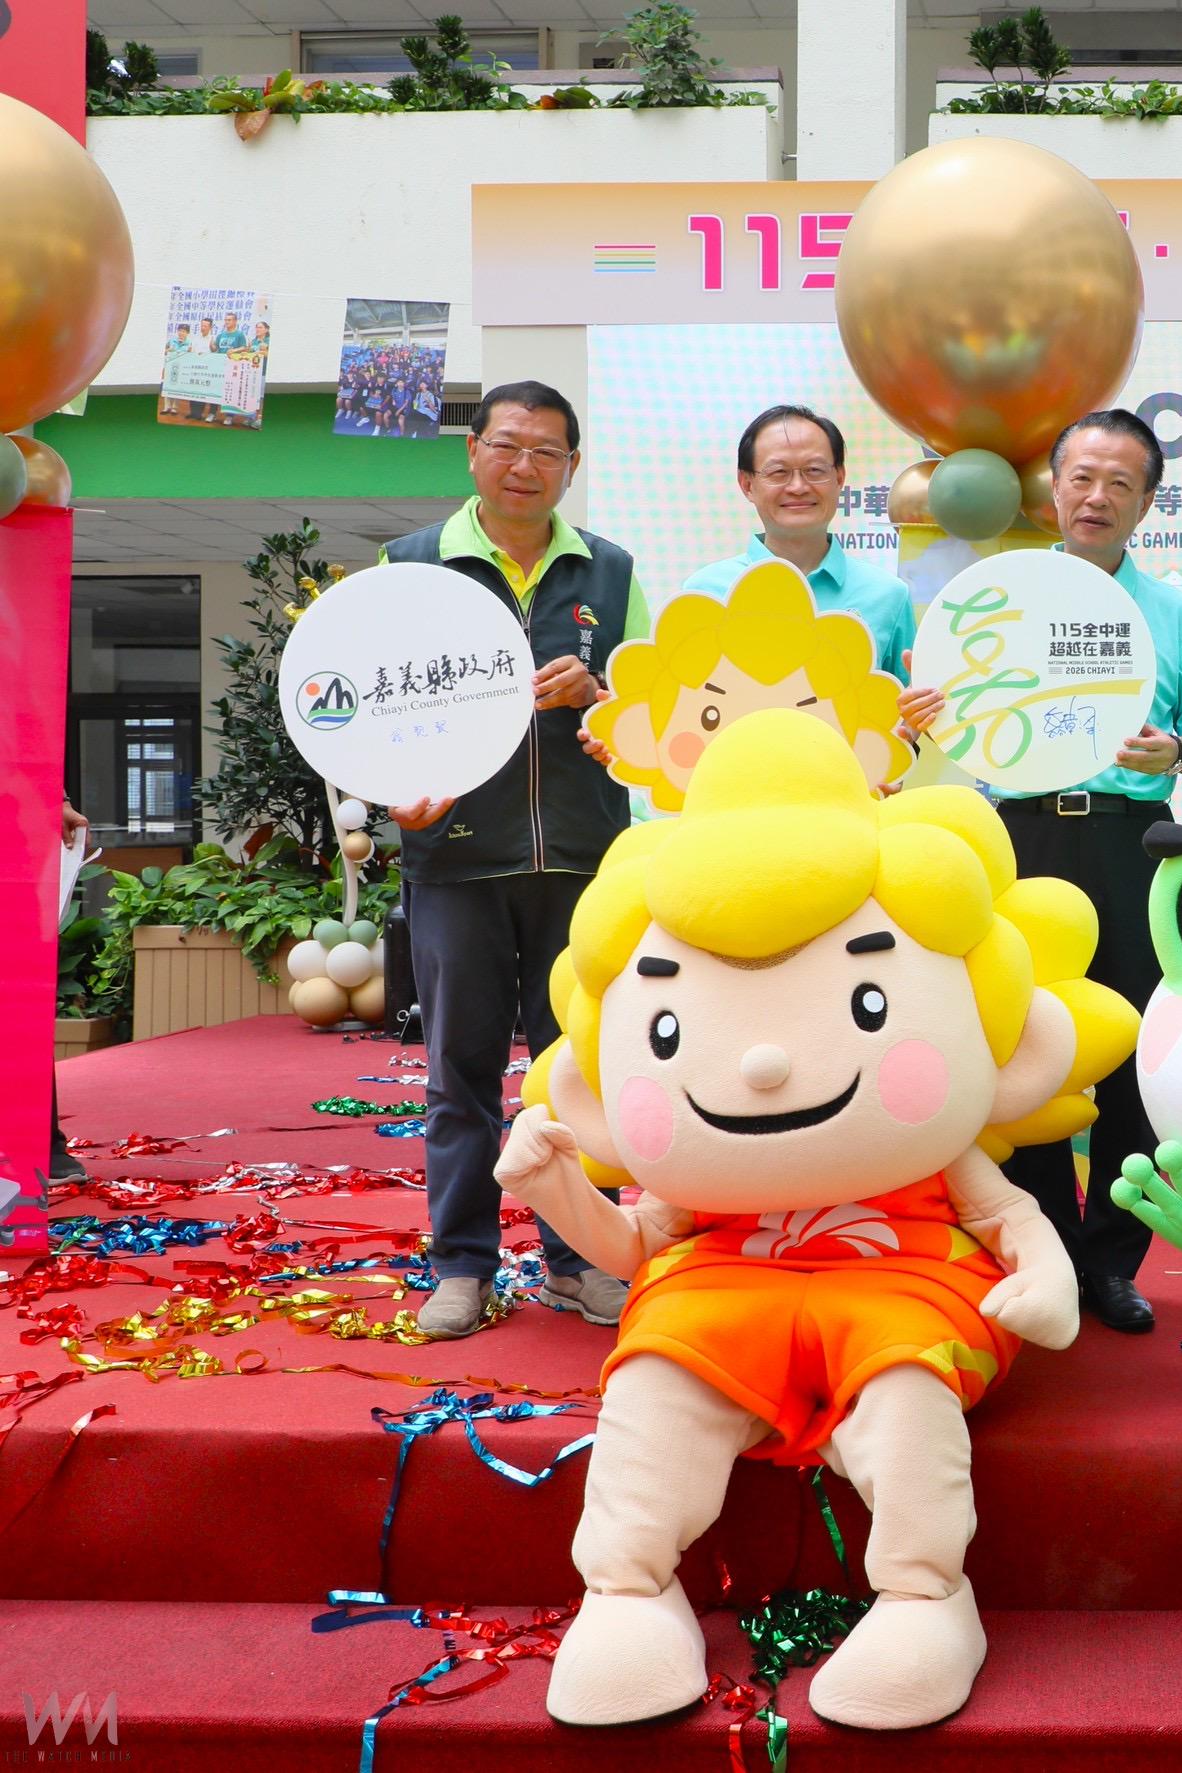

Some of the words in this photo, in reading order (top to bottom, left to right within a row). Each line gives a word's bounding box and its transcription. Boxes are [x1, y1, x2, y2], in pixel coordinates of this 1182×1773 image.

[833, 533, 897, 550] NATION
[1049, 622, 1131, 638] 115全中運
[1048, 641, 1132, 657] 超越在嘉義
[363, 649, 516, 703] 嘉義縣政府
[1065, 666, 1086, 675] 2026
[1087, 666, 1115, 675] CHIAYI
[371, 703, 407, 718] Chiayi
[410, 697, 450, 711] County
[452, 685, 520, 704] Government
